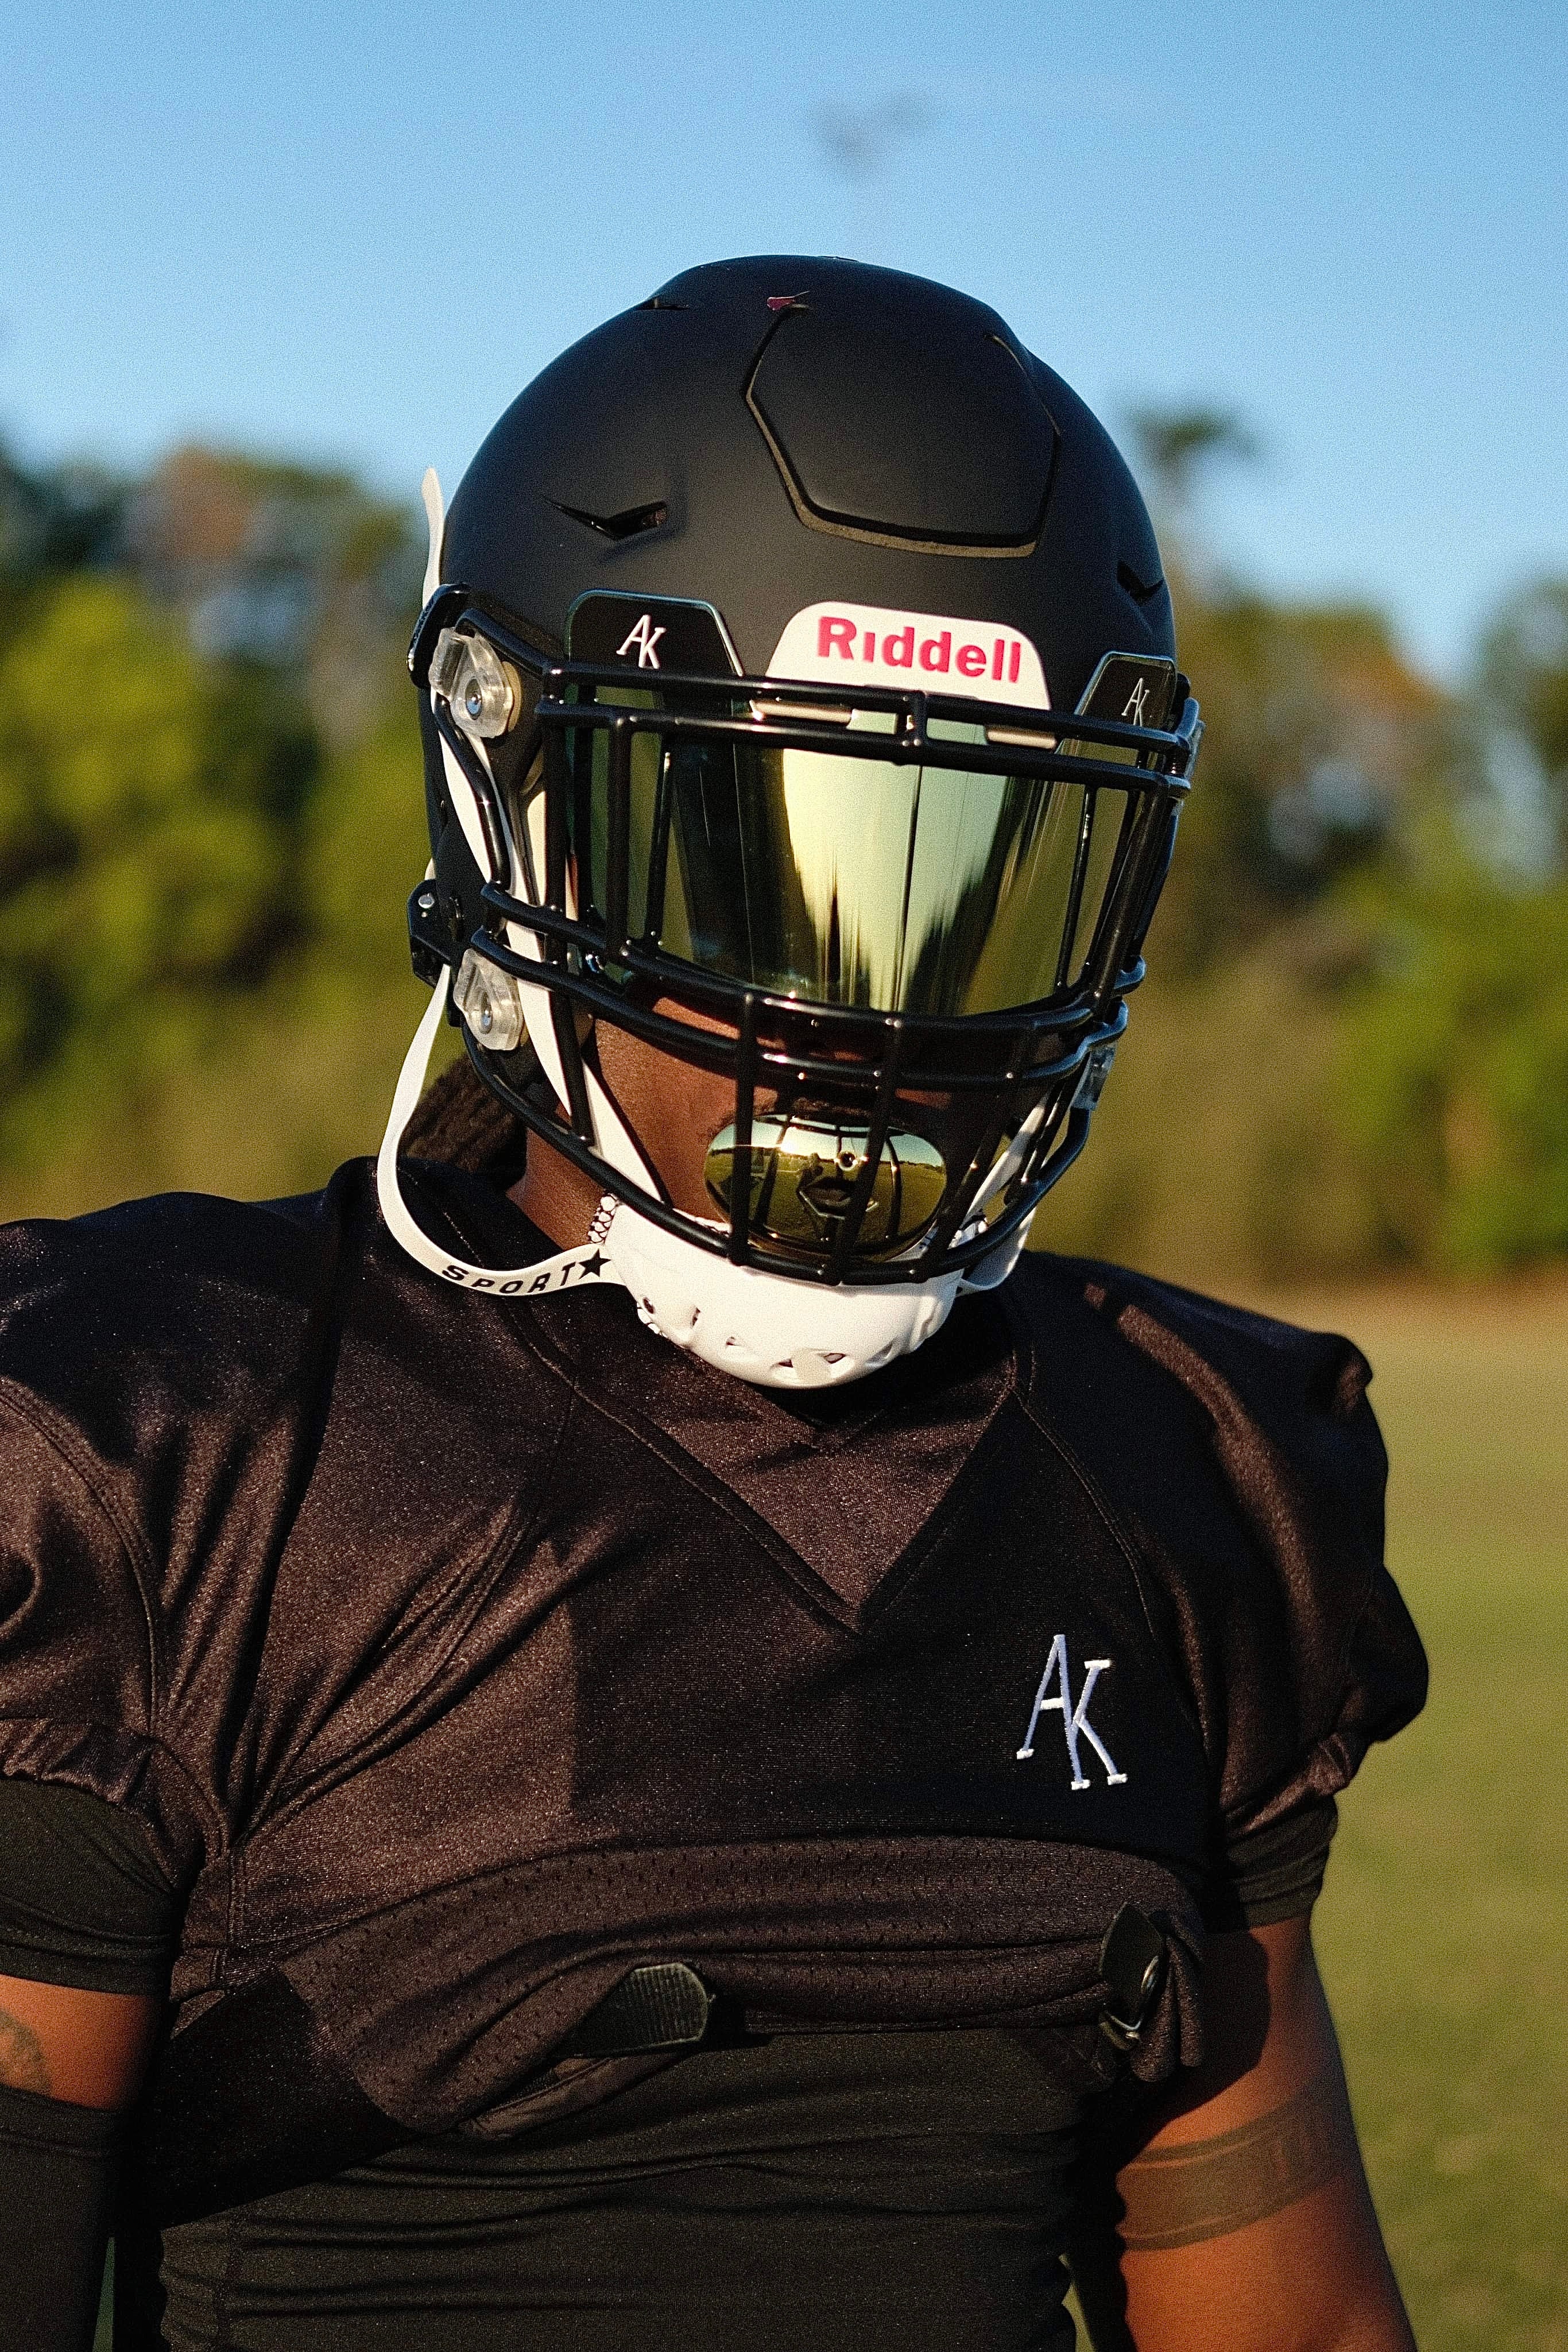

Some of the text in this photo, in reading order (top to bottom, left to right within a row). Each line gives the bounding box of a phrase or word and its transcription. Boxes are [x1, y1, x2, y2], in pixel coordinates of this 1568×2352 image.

[616, 614, 666, 669] AK
[818, 616, 1021, 683] Riddell
[1121, 678, 1149, 726] AK
[442, 1262, 576, 1294] SPORT
[1016, 1634, 1128, 1790] AK
